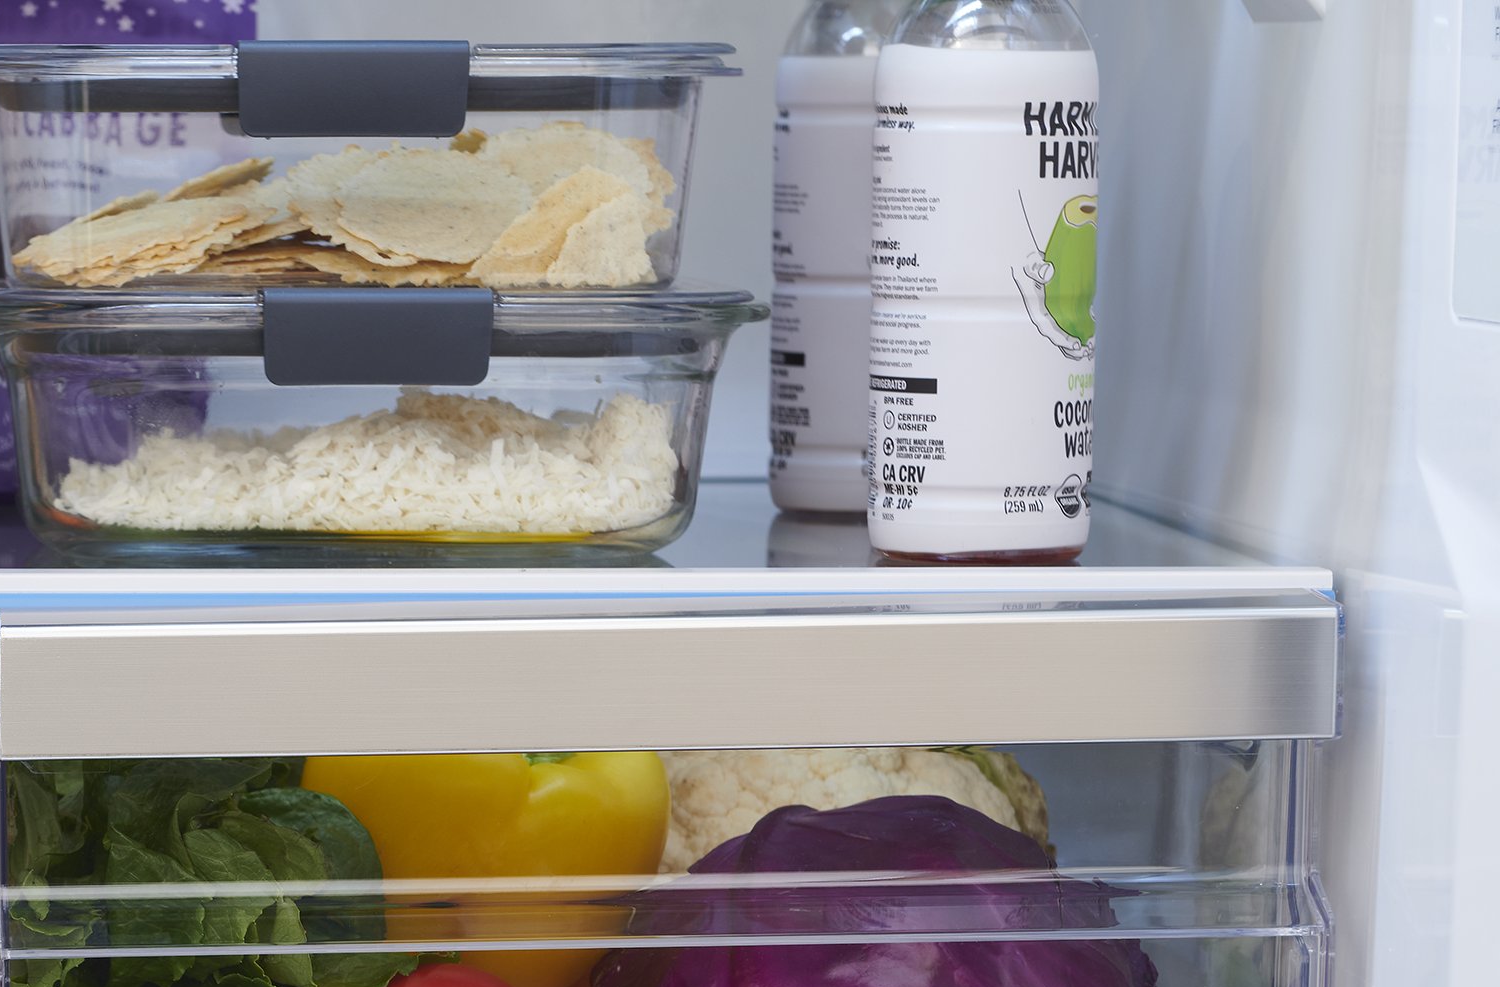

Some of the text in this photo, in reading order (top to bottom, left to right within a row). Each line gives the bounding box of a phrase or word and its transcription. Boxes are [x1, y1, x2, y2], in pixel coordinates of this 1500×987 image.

[896, 252, 920, 271] good.
[897, 275, 919, 283] Thailand
[919, 276, 937, 284] where
[908, 339, 919, 347] day
[896, 397, 914, 406] FREE
[897, 413, 937, 423] CERTIFIED
[897, 422, 928, 432] KOSHER
[908, 446, 934, 454] RECYCLED
[882, 463, 926, 484] CA CRV
[906, 485, 919, 497] 5¢
[1003, 486, 1026, 498] 8.75
[1027, 486, 1037, 497] FL
[1004, 500, 1026, 514] (259
[1028, 500, 1044, 513] mL)
